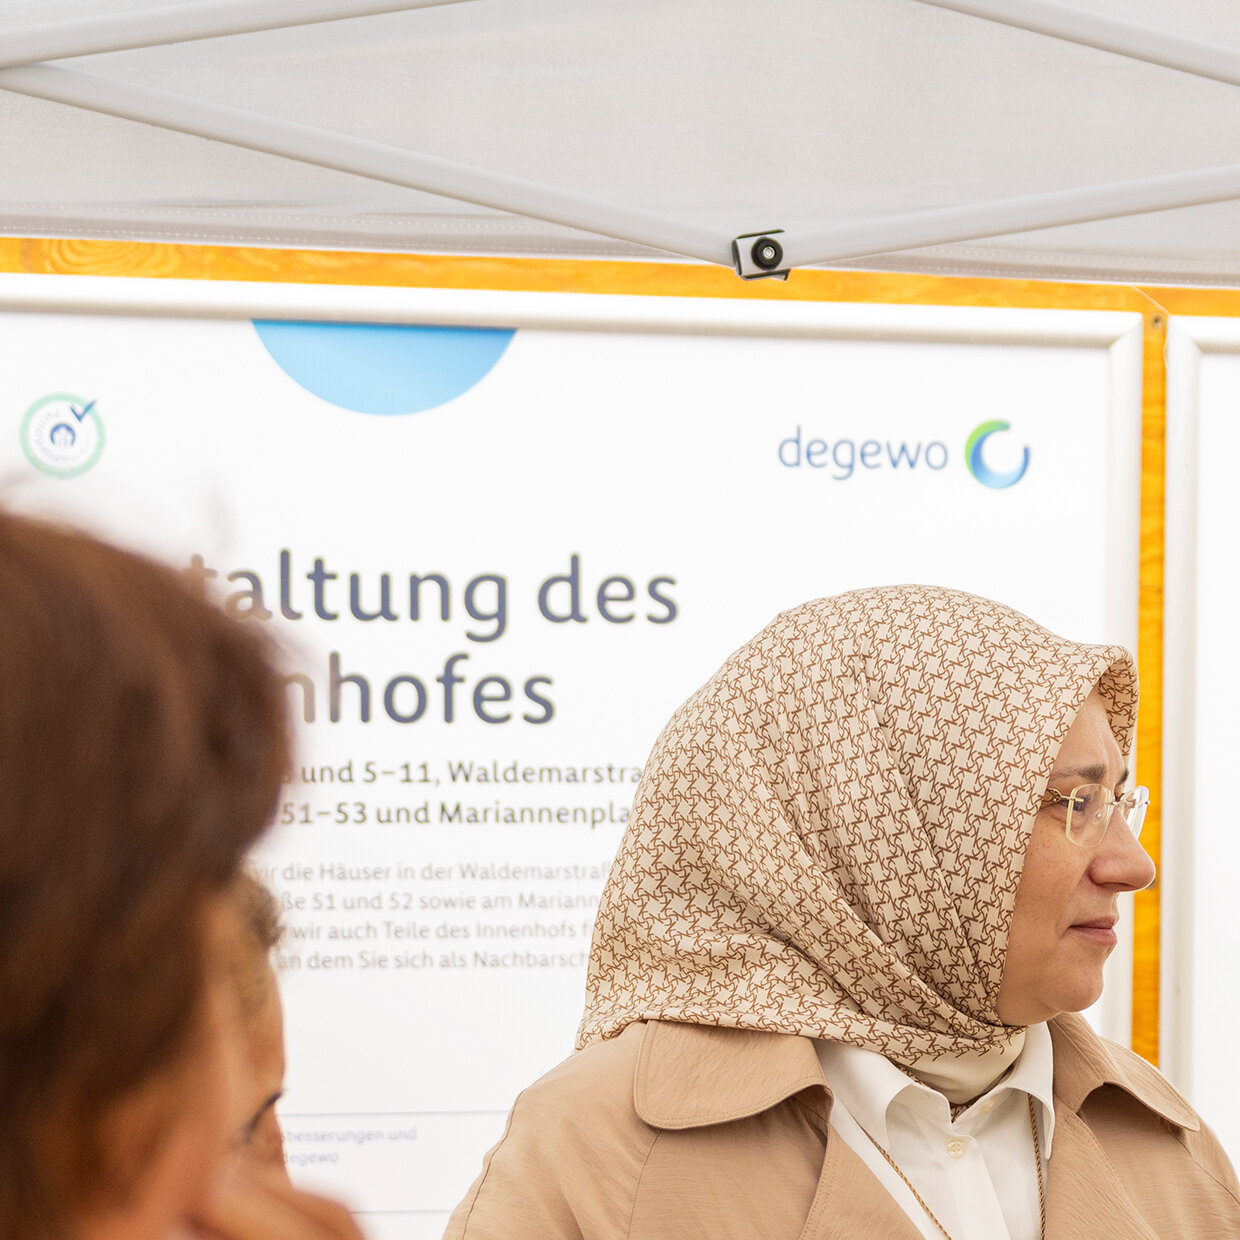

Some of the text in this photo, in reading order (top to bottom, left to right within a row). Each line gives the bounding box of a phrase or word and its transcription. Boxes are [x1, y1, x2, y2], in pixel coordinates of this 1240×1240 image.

[777, 424, 948, 481] degewo
[537, 553, 679, 624] des
[301, 760, 354, 783] und
[376, 801, 430, 824] und
[283, 861, 313, 881] die
[320, 861, 391, 881] Häuser
[397, 862, 416, 881] in
[420, 862, 453, 881] der
[342, 893, 384, 911] und
[420, 893, 475, 911] sowie
[481, 897, 513, 911] am
[328, 922, 377, 940] auch
[384, 922, 429, 940] Teile
[436, 922, 470, 940] des
[477, 921, 576, 940] Innenhofs
[307, 951, 353, 970] dem
[359, 952, 387, 970] Sie
[395, 951, 433, 970] sich
[439, 951, 467, 970] als
